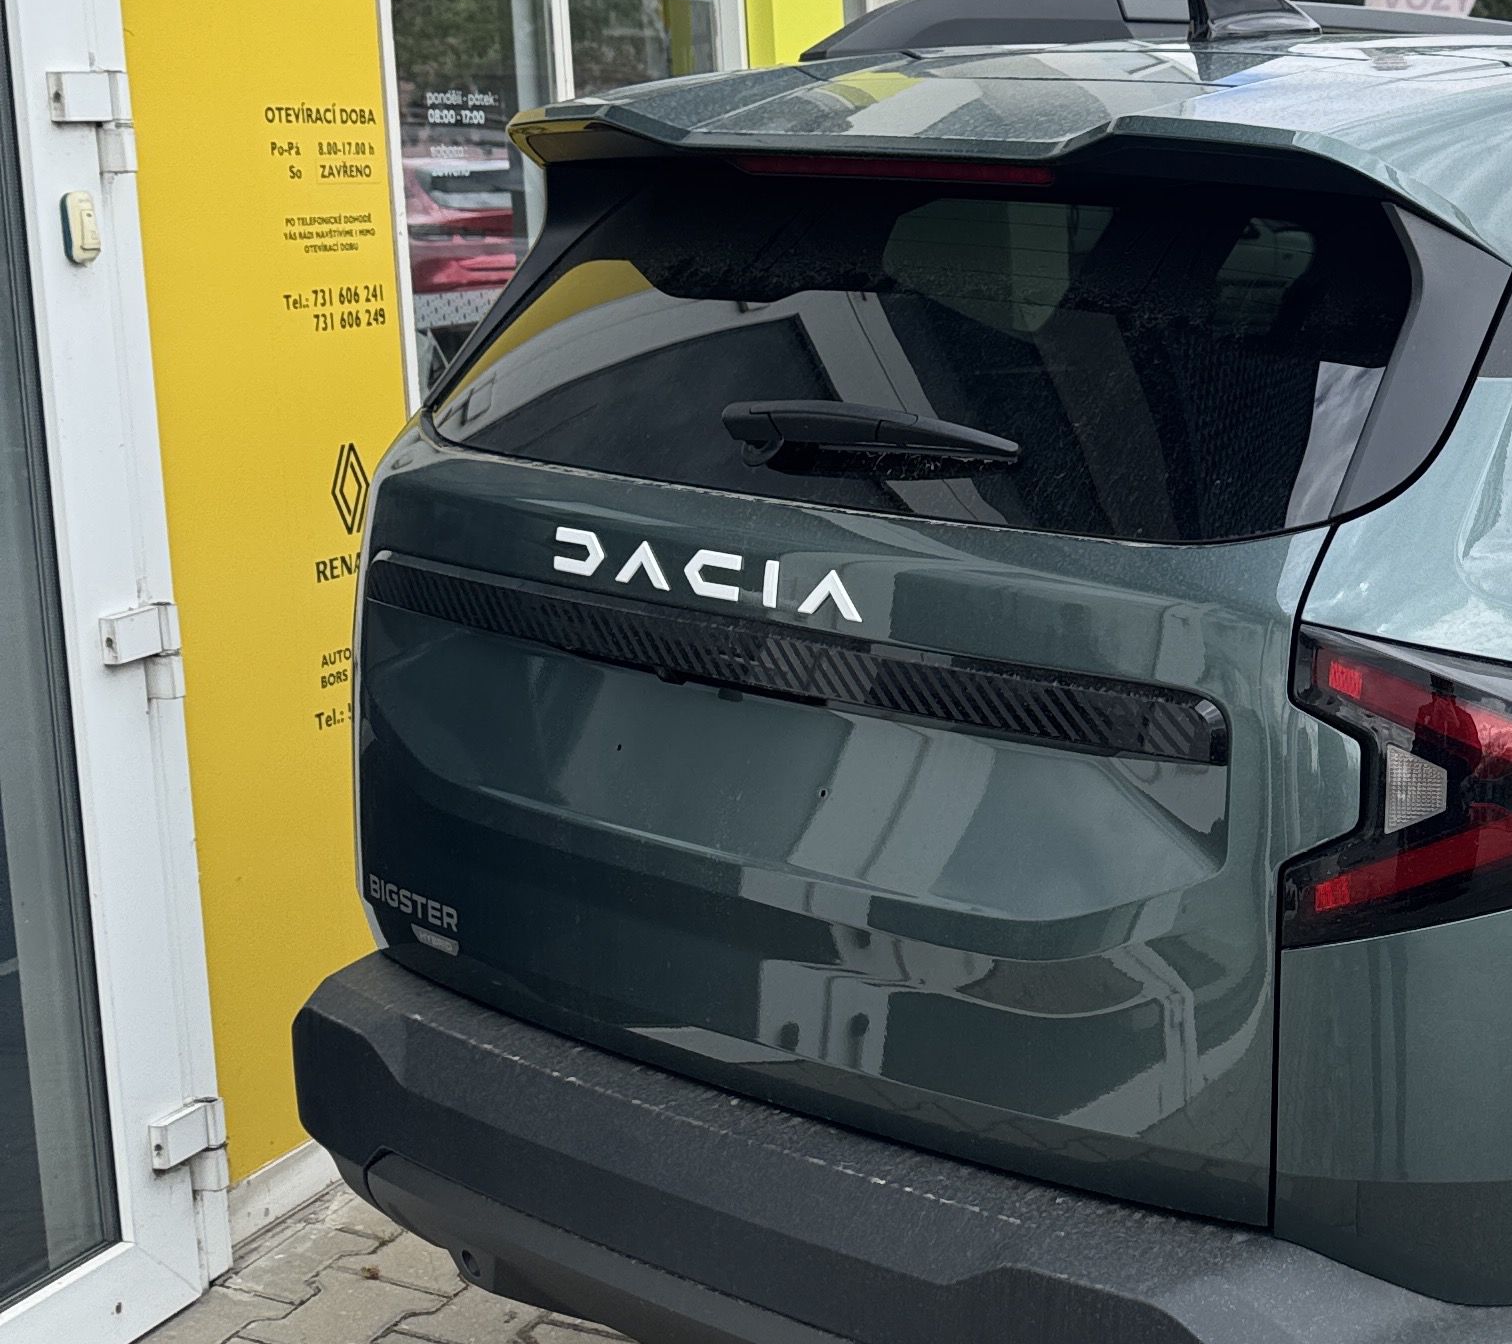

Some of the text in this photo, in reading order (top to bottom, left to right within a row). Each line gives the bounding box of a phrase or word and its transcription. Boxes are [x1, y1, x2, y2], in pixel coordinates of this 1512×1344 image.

[264, 101, 377, 125] OTEVÍRACÍ DOBA
[288, 160, 373, 180] So ZAVŘENO
[283, 283, 384, 311] Tel.: 731 606 241
[313, 307, 387, 333] 731 606 249
[315, 551, 361, 584] RENA
[553, 525, 864, 624] DACIA
[320, 668, 349, 689] BORS
[314, 708, 345, 731] Tel.:
[369, 873, 459, 933] BIGSTER
